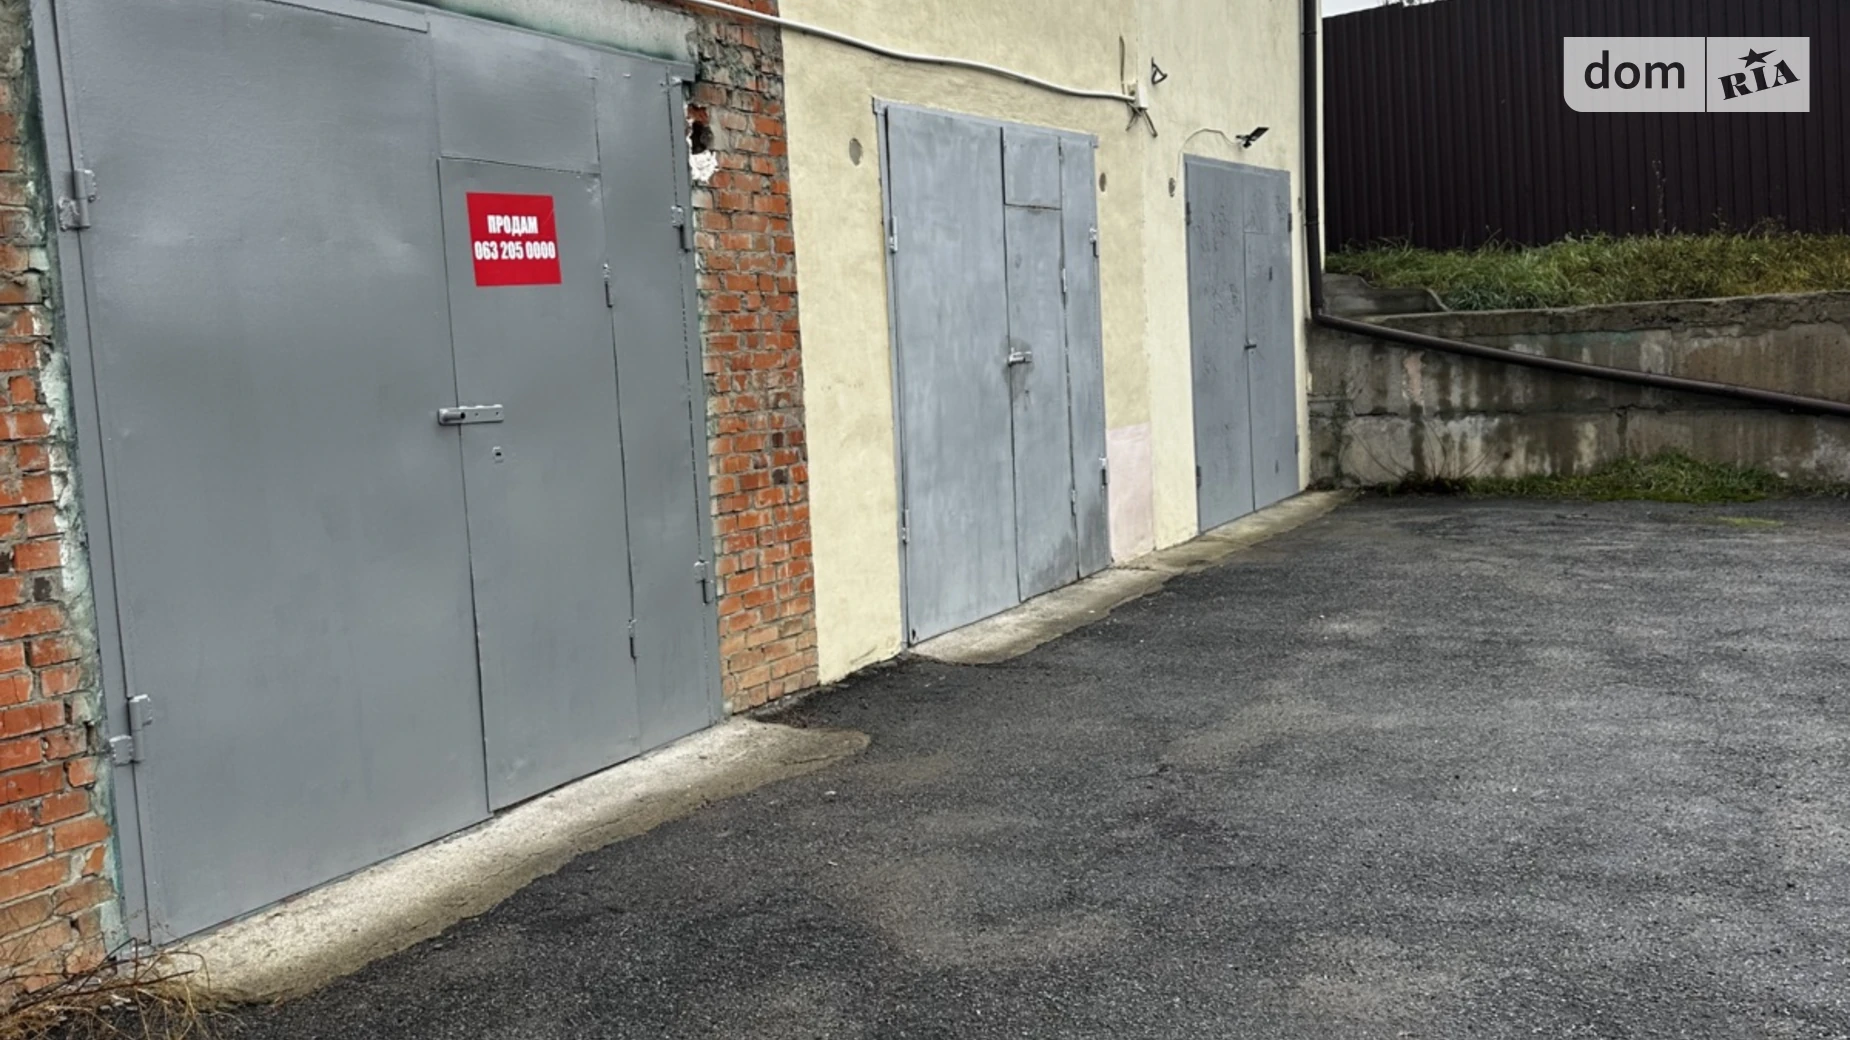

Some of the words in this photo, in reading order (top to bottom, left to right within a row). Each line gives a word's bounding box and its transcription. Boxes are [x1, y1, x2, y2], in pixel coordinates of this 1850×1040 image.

[487, 214, 539, 237] ПРОДАМ
[474, 240, 499, 260] 063
[500, 240, 524, 260] 205
[525, 240, 556, 259] 0000
